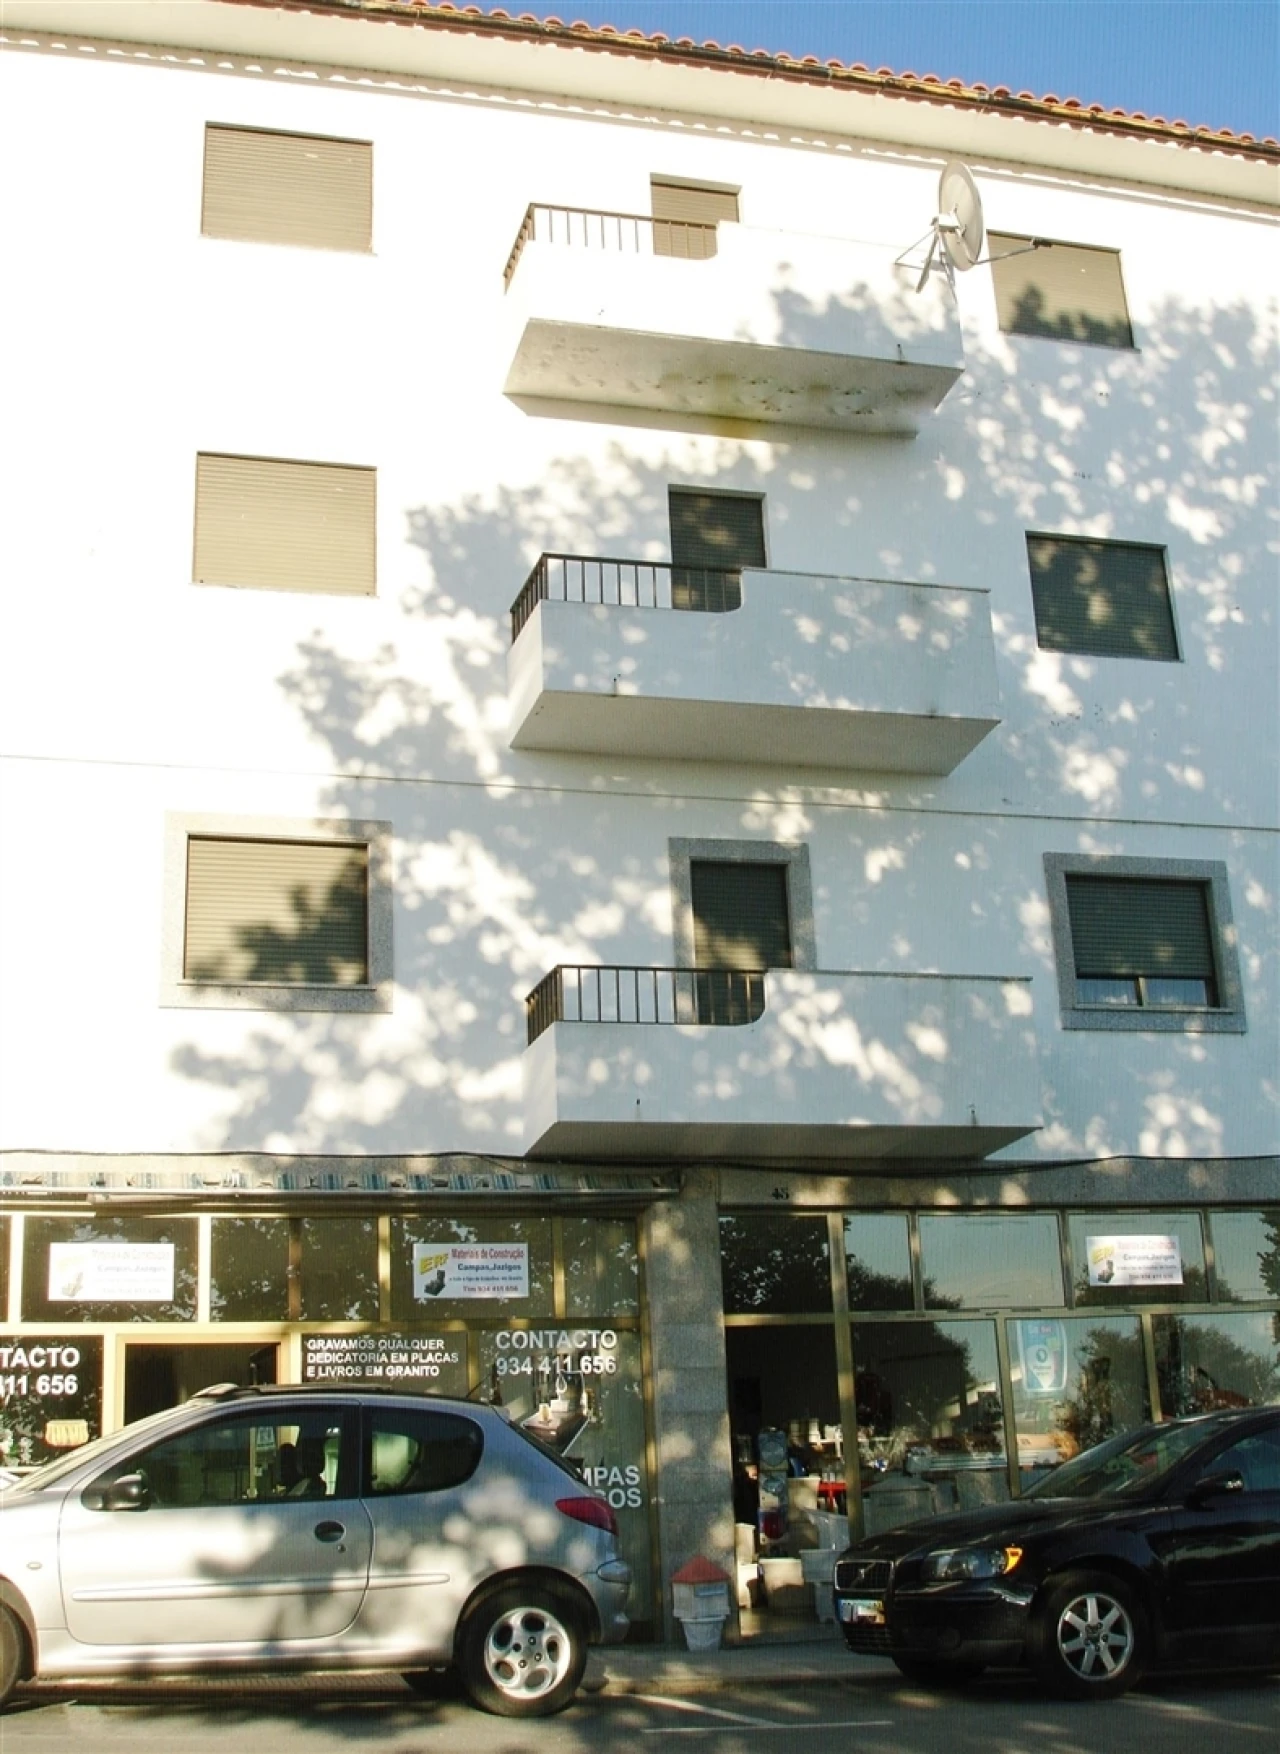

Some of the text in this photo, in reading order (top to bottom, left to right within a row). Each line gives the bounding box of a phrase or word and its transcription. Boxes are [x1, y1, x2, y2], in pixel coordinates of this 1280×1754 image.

[306, 1338, 446, 1351] GRAVAMOS QUALQUER
[495, 1329, 618, 1349] CONTACTO
[390, 1351, 409, 1363] EM
[411, 1351, 459, 1363] PLACAS
[496, 1355, 618, 1375] 934 411 656
[306, 1365, 441, 1378] E LIVROS EM GRANITO
[36, 1374, 79, 1396] 656
[594, 1487, 642, 1509] OS
